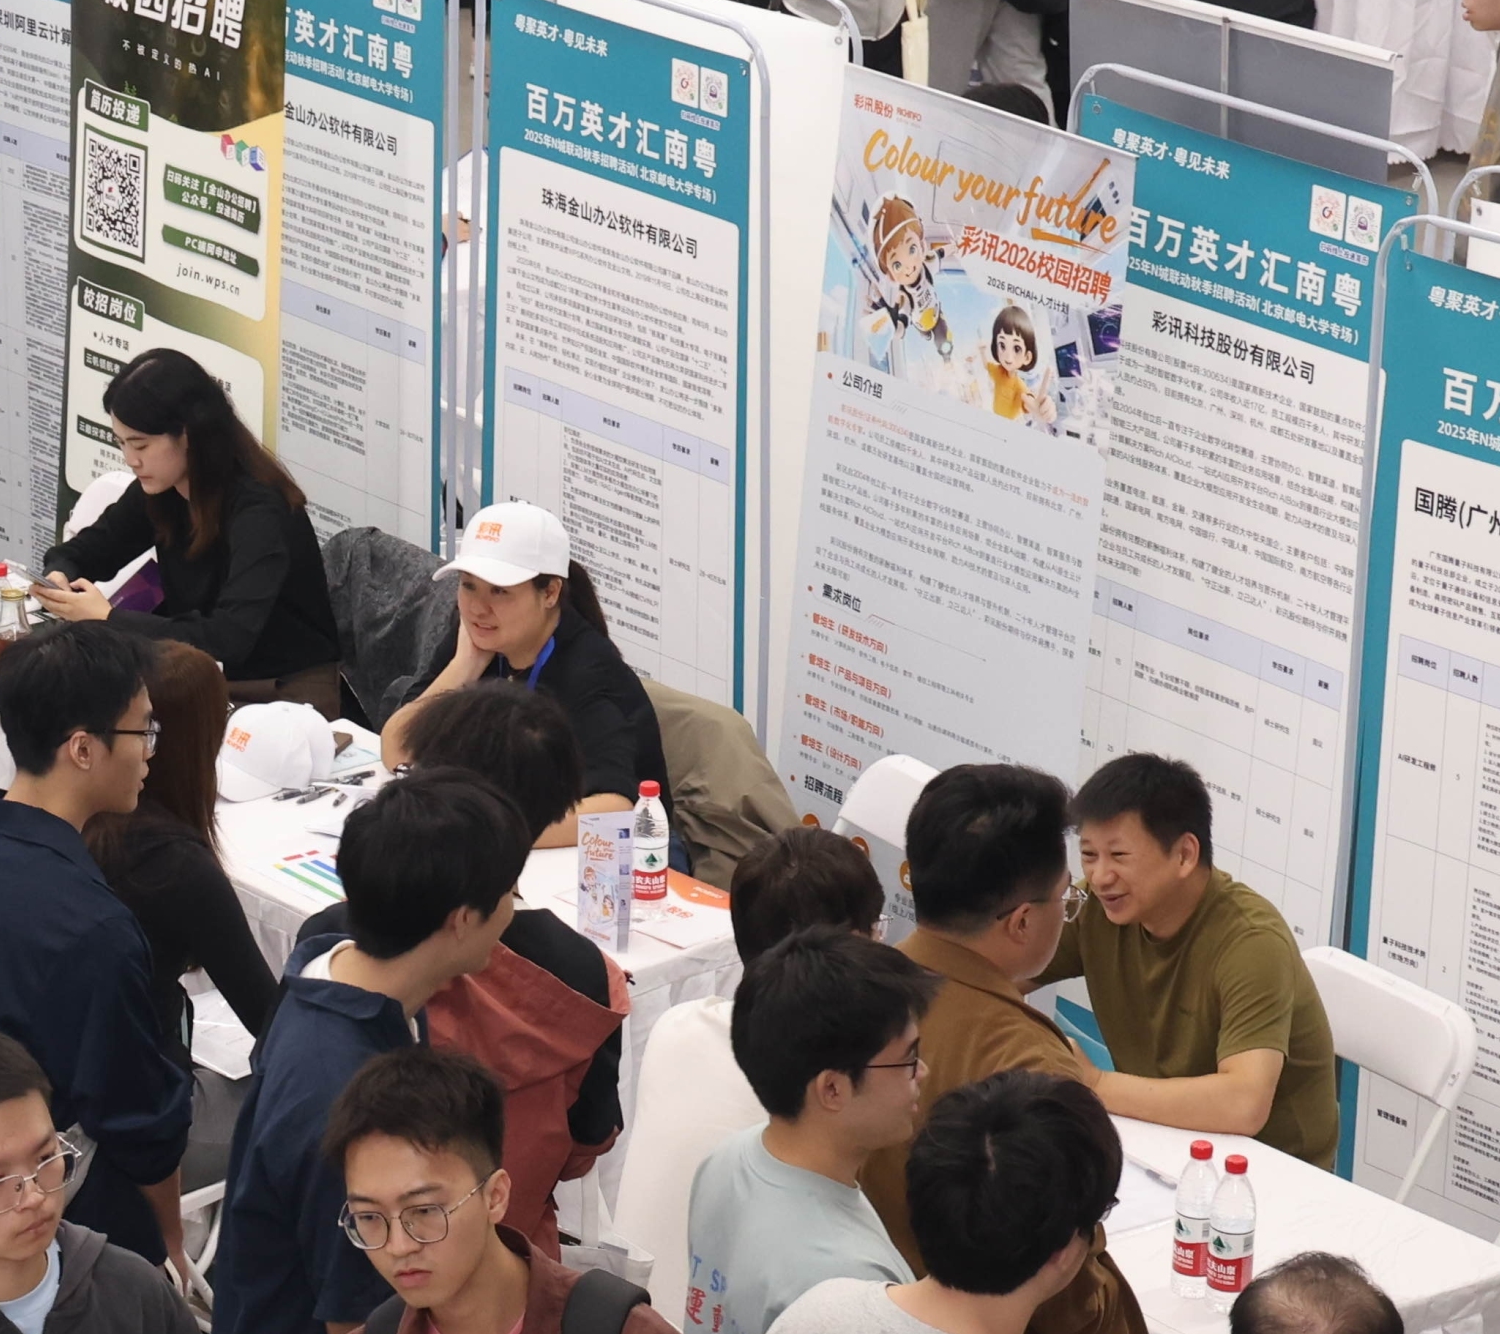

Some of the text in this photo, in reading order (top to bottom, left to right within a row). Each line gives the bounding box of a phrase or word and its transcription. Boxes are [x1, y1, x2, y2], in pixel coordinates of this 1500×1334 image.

[514, 13, 609, 58] 粤聚英才·粤见未来
[89, 88, 142, 127] 简历投递
[853, 92, 894, 121] 彩讯股份
[284, 99, 399, 157] 金山办公软件有限公司
[524, 82, 718, 179] 百万英才汇南粤
[1112, 127, 1232, 181] 粤聚英才·粤见未来
[863, 129, 1119, 244] Colour your future
[541, 187, 699, 260] 珠海金山办公软件有限公司
[176, 262, 242, 298] join.wps.cn
[956, 224, 1113, 306] 彩讯2026校园招聘
[1127, 205, 1364, 318] 百万英才汇南粤
[987, 275, 1006, 292] 2026
[82, 286, 138, 326] 校招岗位
[98, 330, 130, 352] 人才专项
[1151, 309, 1317, 386] 彩讯科技股份有限公司
[841, 369, 884, 399] 公司介绍
[821, 583, 863, 614] 需求岗位
[811, 611, 889, 655] 管培生（研发技术方向）
[800, 733, 863, 772] 管培生（设计方向）
[803, 773, 844, 805] 招聘流程
[581, 831, 614, 849] Colour
[584, 847, 615, 862] future
